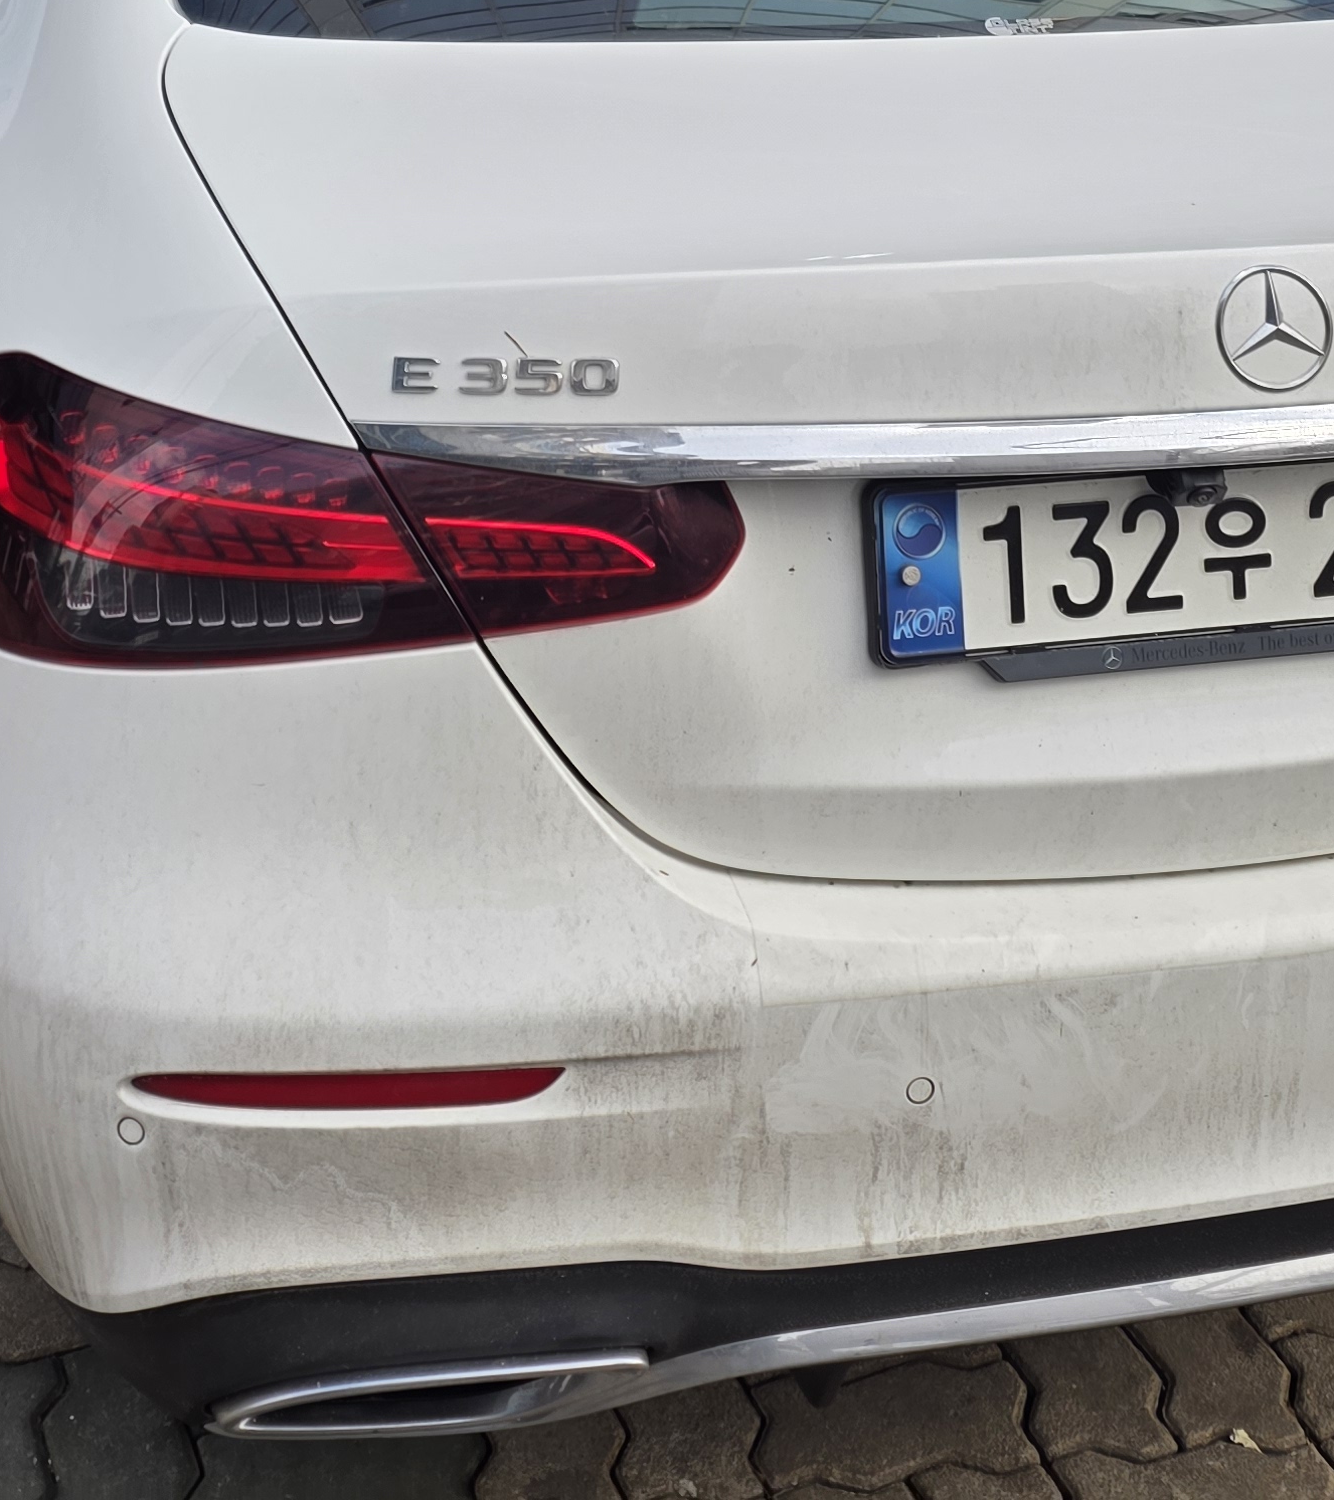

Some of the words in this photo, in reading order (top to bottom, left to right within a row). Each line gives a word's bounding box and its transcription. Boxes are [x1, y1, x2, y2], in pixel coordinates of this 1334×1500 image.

[390, 355, 441, 395] E
[457, 356, 621, 397] 350
[981, 495, 1273, 625] 132우
[892, 605, 956, 641] KOR
[1130, 637, 1246, 665] Mercedes-Benz
[1257, 633, 1289, 651] The
[1288, 629, 1320, 649] best
